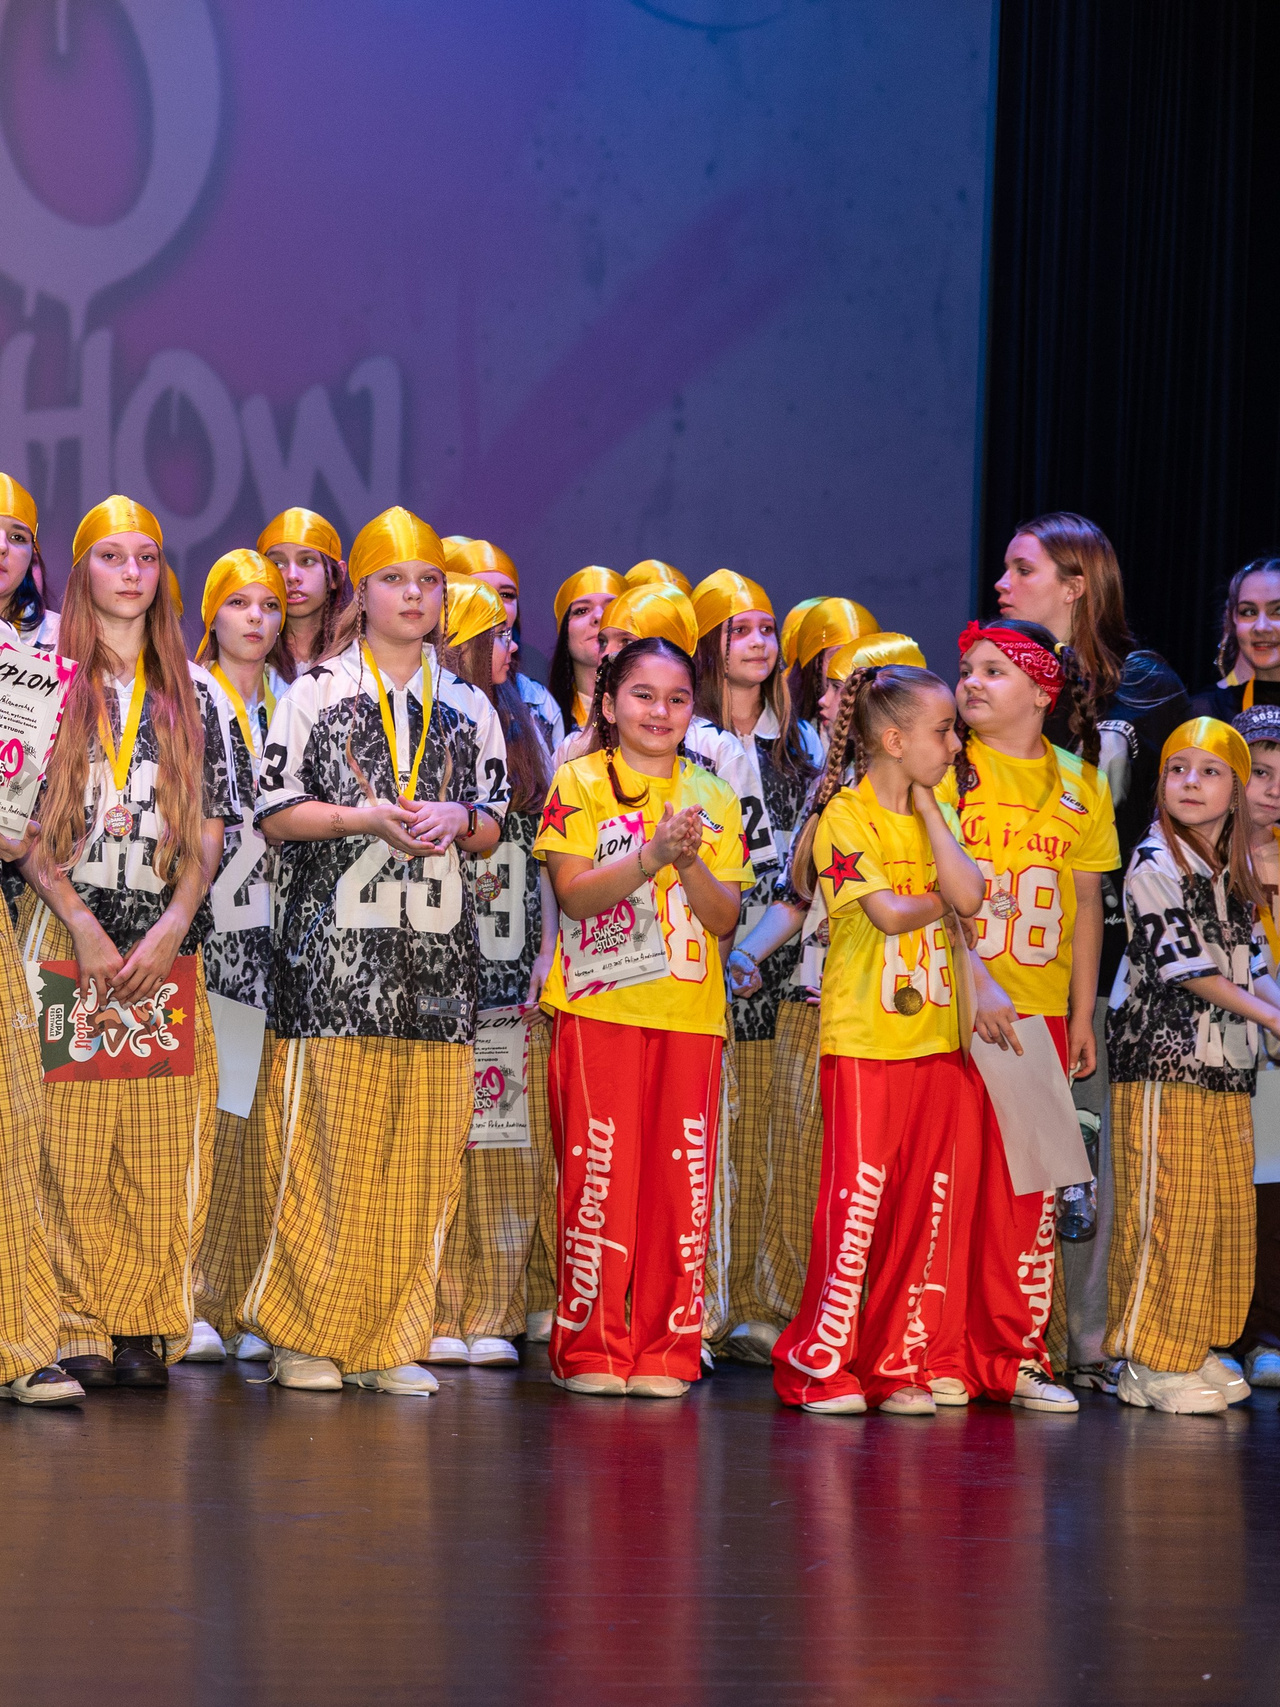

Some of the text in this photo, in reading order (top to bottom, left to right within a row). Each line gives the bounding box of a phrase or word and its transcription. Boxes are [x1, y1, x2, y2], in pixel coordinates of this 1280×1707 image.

[3, 725, 24, 734] STUDIO
[259, 742, 288, 792] 3
[485, 757, 510, 801] 2
[740, 795, 772, 850] 2
[336, 799, 463, 934] 23
[593, 922, 624, 941] DANCE
[596, 933, 626, 953] STUDIO
[1140, 907, 1203, 968] 23
[55, 1007, 63, 1037] GRUPA
[71, 980, 99, 1051] Rudolf
[556, 1116, 628, 1333] California
[787, 1161, 887, 1379] California
